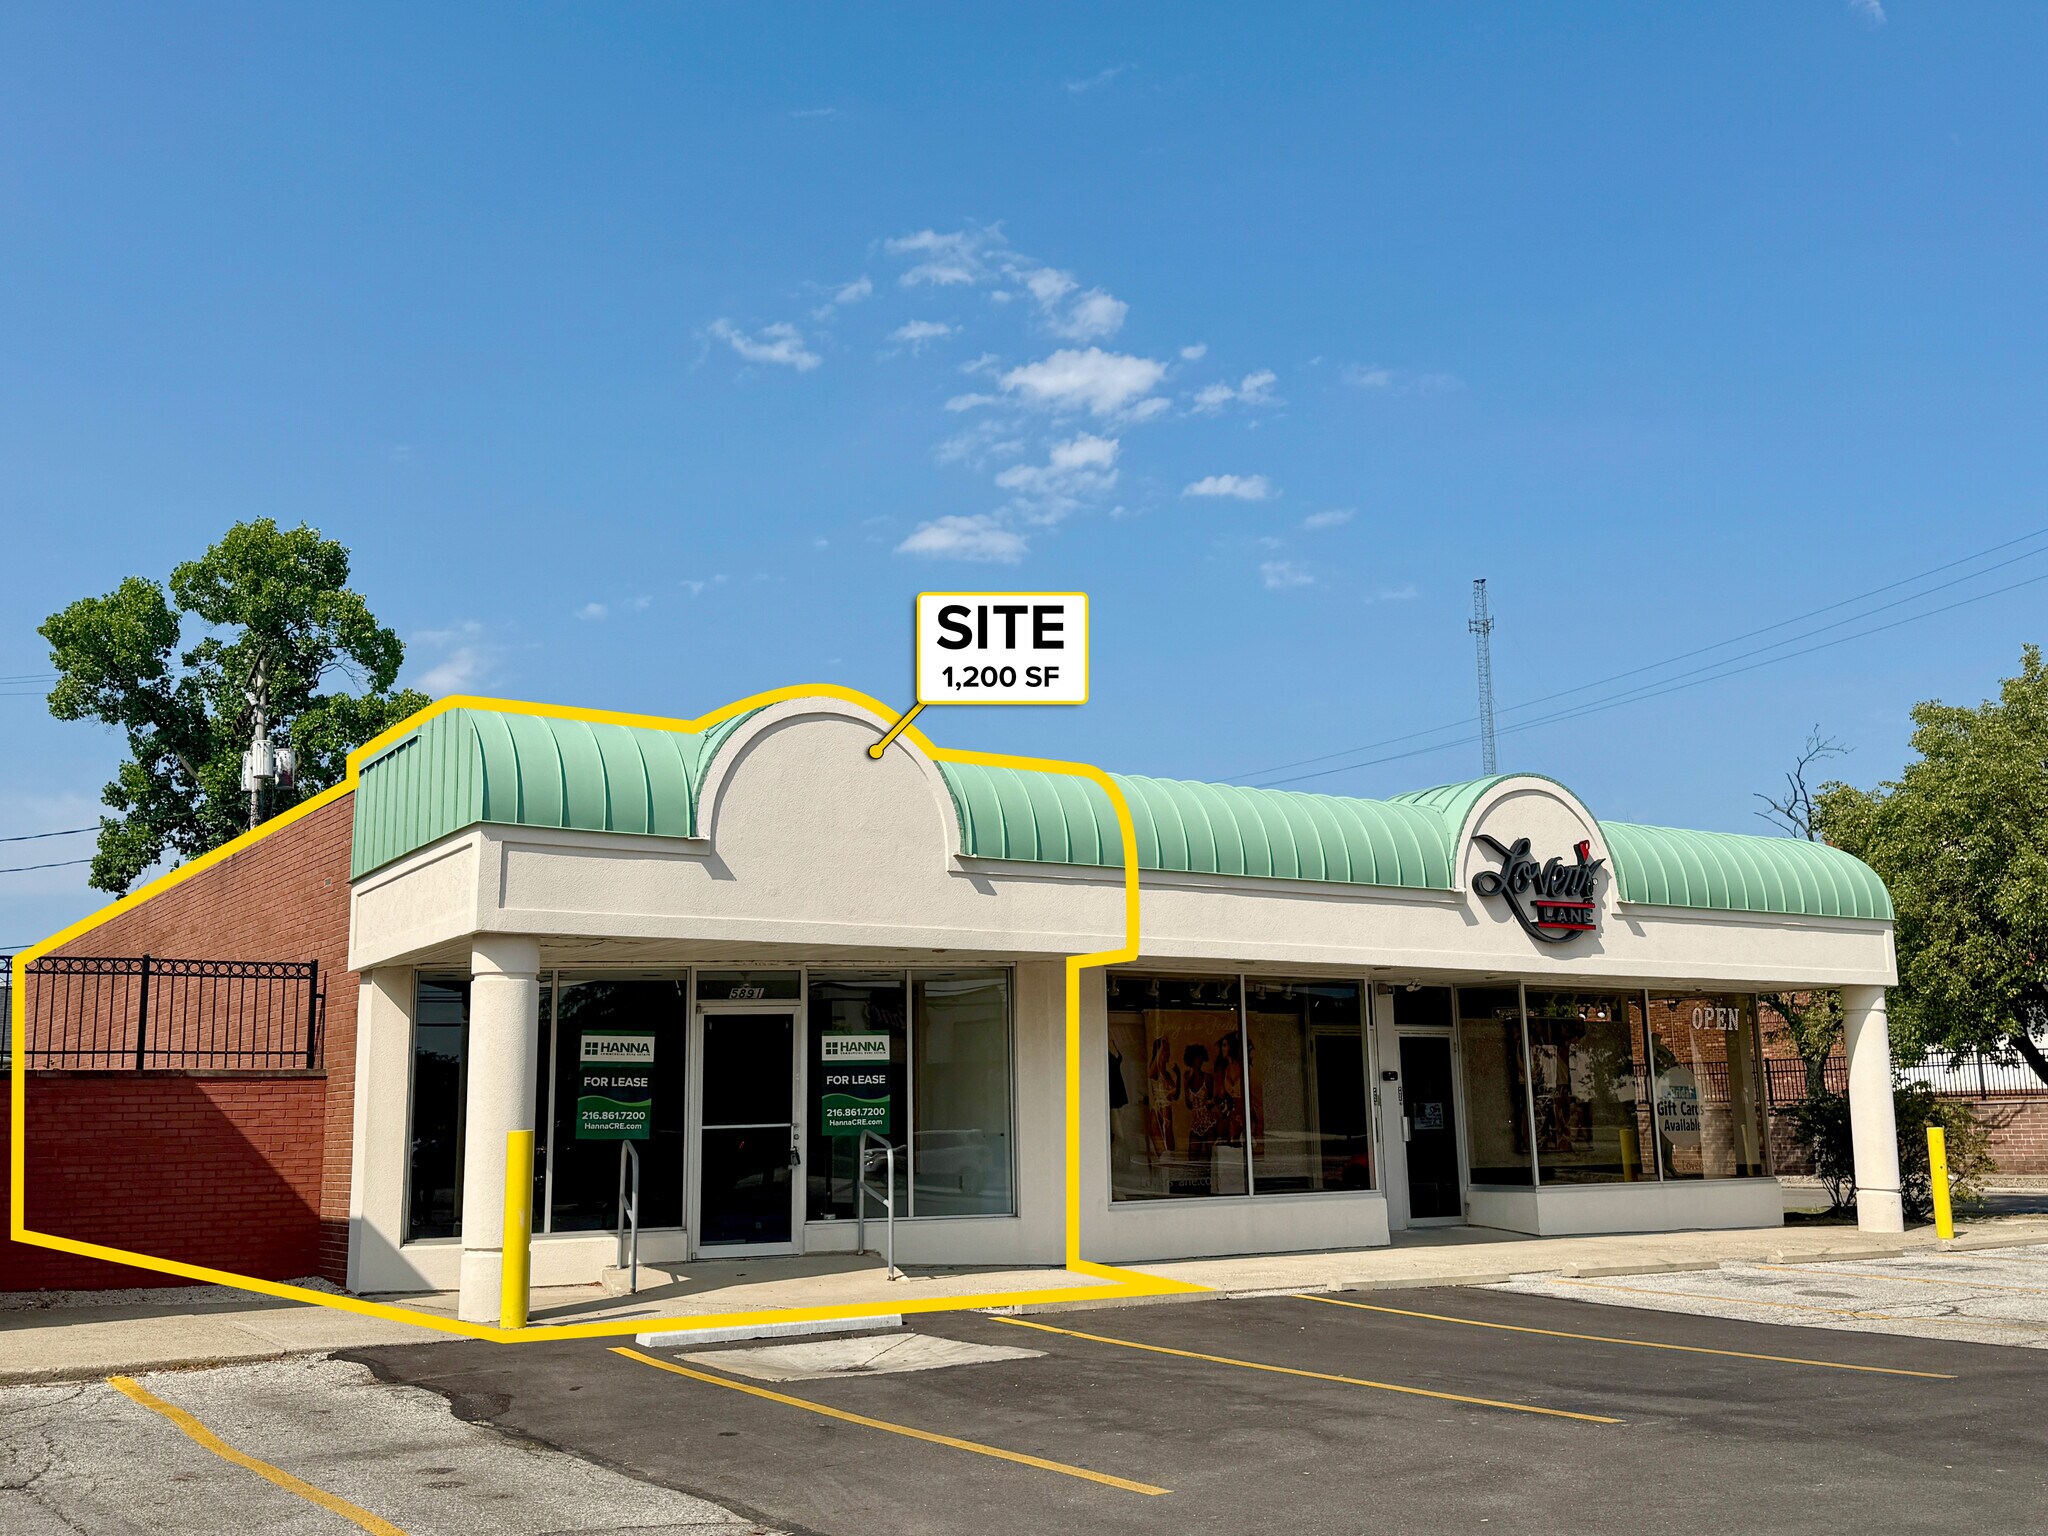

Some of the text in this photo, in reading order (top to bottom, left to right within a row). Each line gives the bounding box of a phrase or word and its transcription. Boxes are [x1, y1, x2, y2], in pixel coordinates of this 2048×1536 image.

[1537, 905, 1594, 923] LANE
[730, 989, 761, 998] 5891
[1692, 1007, 1740, 1031] OPEN
[600, 1042, 650, 1053] HANNA
[840, 1041, 886, 1051] HANNA
[583, 1077, 648, 1087] FOR LEASE
[826, 1075, 886, 1085] FOR LEASE
[826, 1108, 886, 1117] 216.861.7200
[1657, 1100, 1677, 1116] Gift
[582, 1111, 646, 1120] 216.861.7200
[584, 1122, 642, 1130] HannaCRE.com
[829, 1118, 883, 1126] HannaCRE.com
[1664, 1119, 1702, 1131] Available
